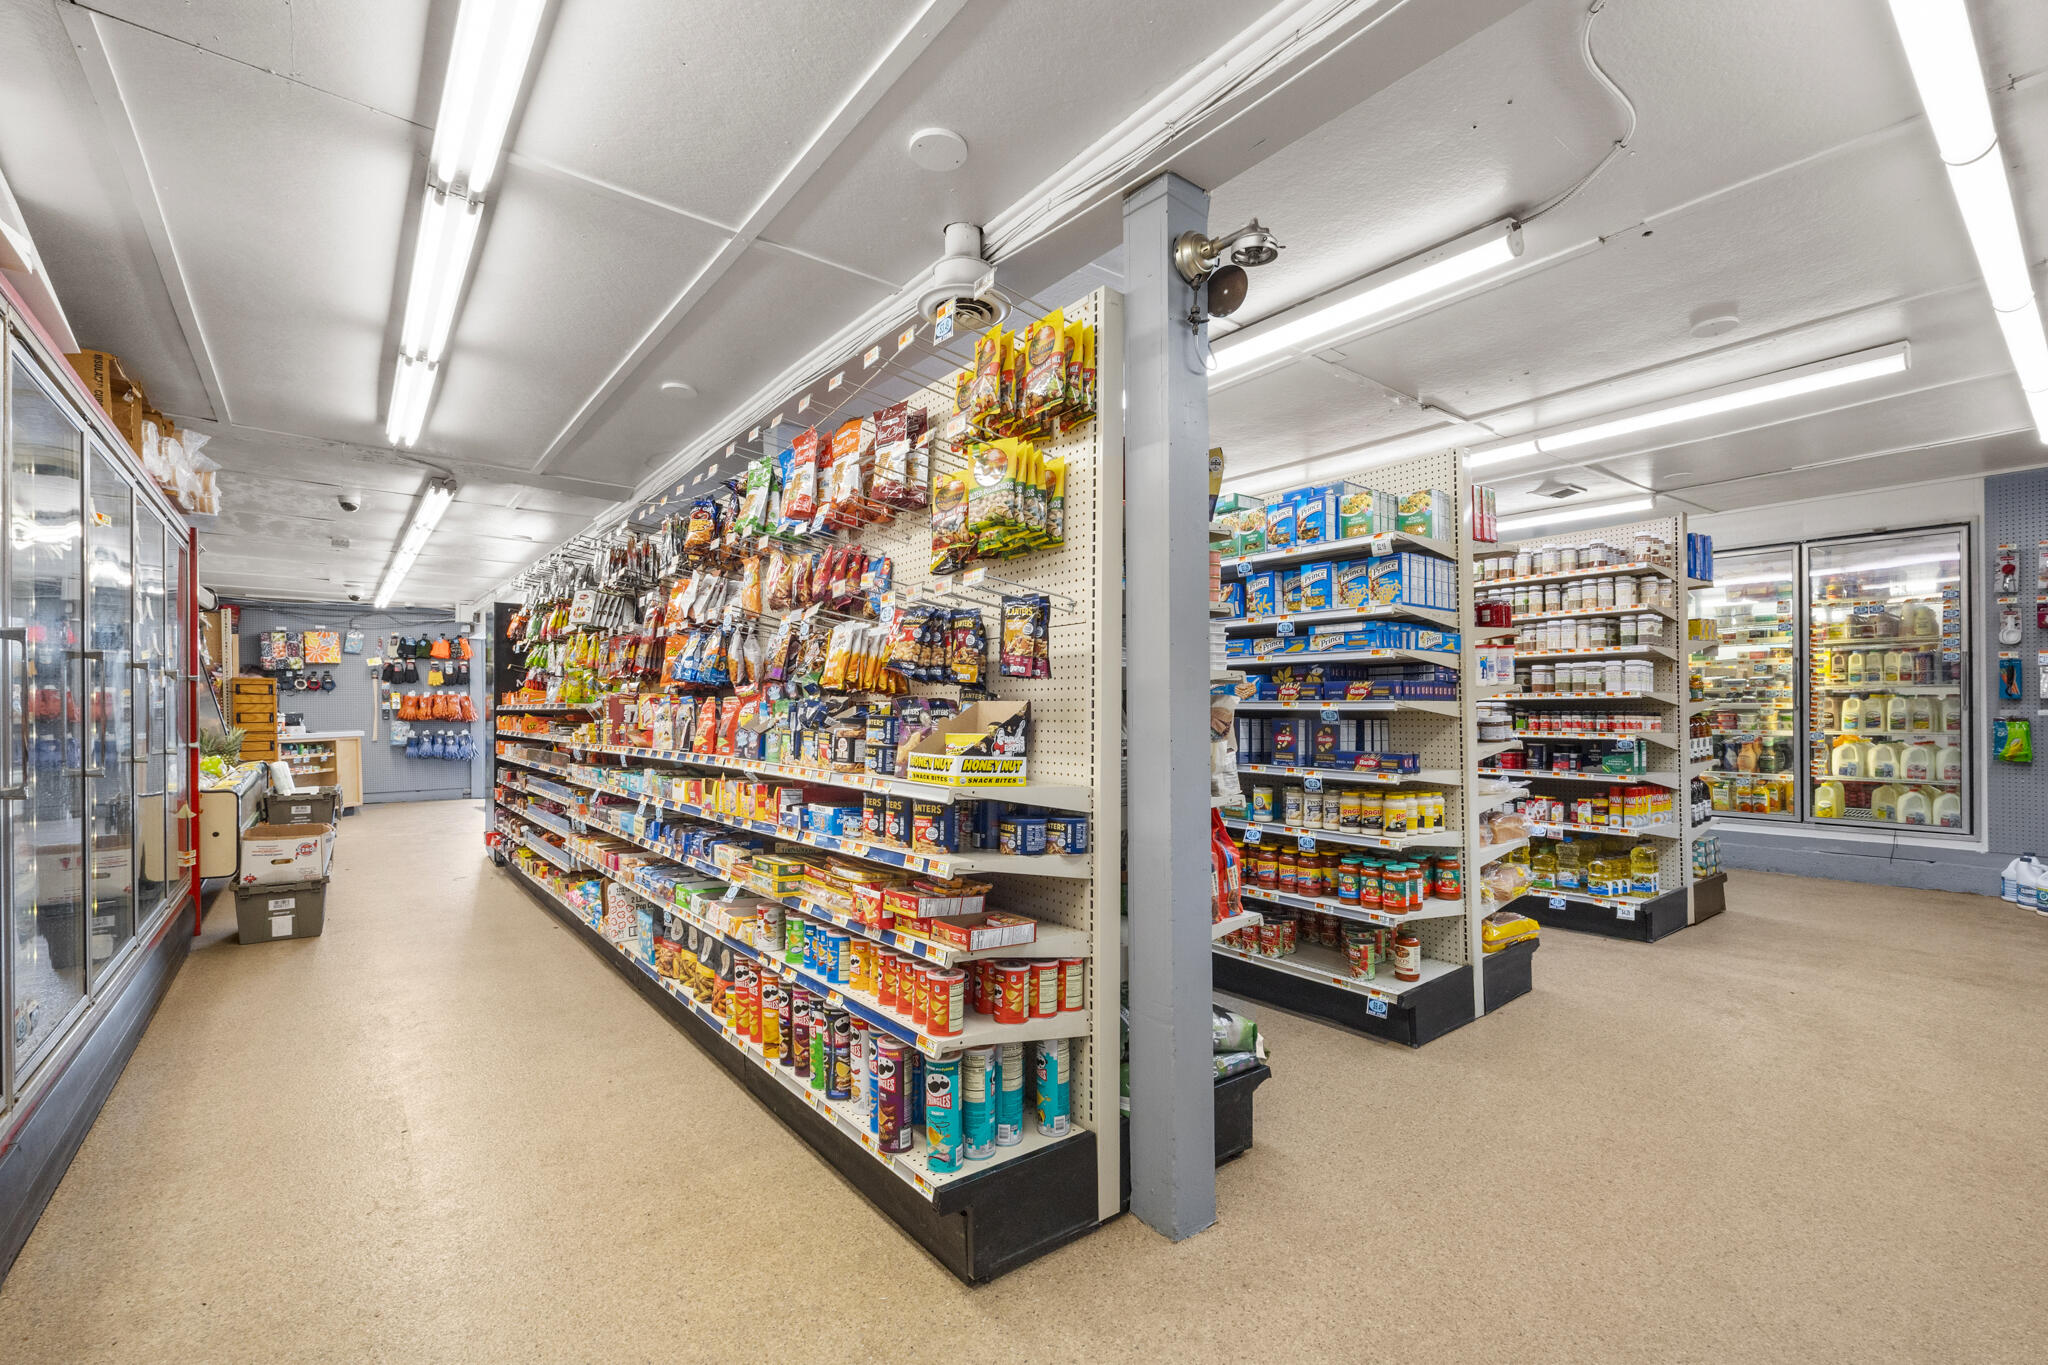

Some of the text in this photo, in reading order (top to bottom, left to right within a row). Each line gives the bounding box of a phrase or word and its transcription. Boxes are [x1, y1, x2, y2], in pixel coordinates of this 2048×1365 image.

[1300, 502, 1321, 516] Prince
[1342, 566, 1365, 580] Prince
[1373, 562, 1397, 576] Prince
[1303, 570, 1326, 583] Prince
[1249, 579, 1268, 591] Prince
[1263, 639, 1284, 651] Prince
[1320, 635, 1344, 649] Prince
[1426, 633, 1442, 645] Prince
[909, 755, 954, 772] HONEY NUT
[961, 759, 1024, 774] HONEY NUT
[913, 773, 948, 783] SNACK BITES
[1343, 808, 1361, 816] RAGU
[1364, 809, 1382, 817] RAGU
